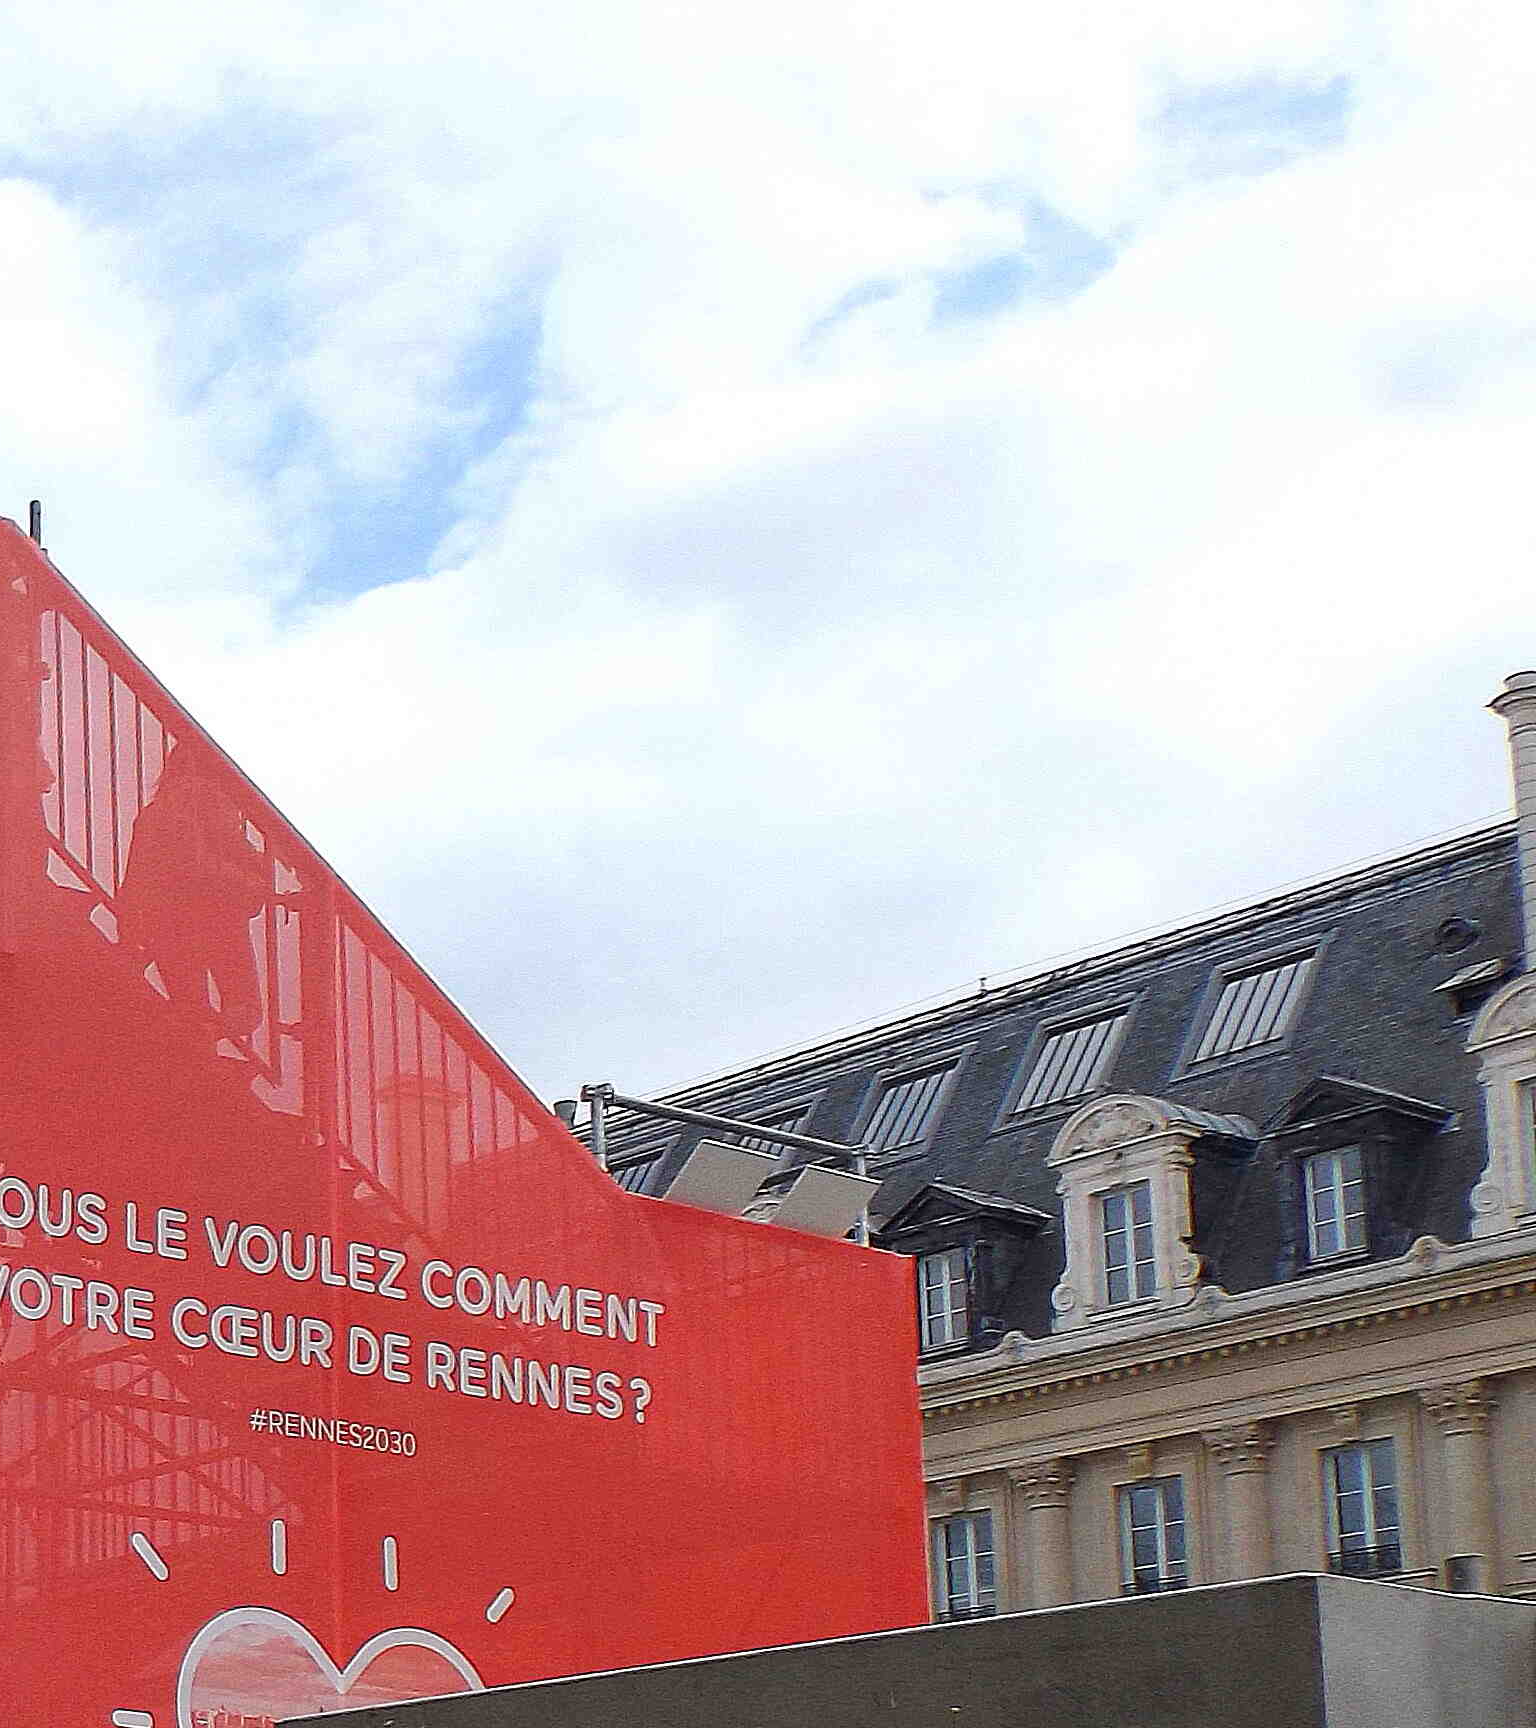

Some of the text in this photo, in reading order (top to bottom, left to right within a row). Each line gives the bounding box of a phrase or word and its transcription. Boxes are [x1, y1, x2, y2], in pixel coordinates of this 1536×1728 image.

[125, 1202, 188, 1261] LE
[203, 1216, 408, 1301] VOULEZ
[421, 1259, 665, 1348] COMMENT
[171, 1297, 333, 1370] CŒUR
[347, 1325, 412, 1385] DE
[248, 1407, 416, 1457] #RENNES2030
